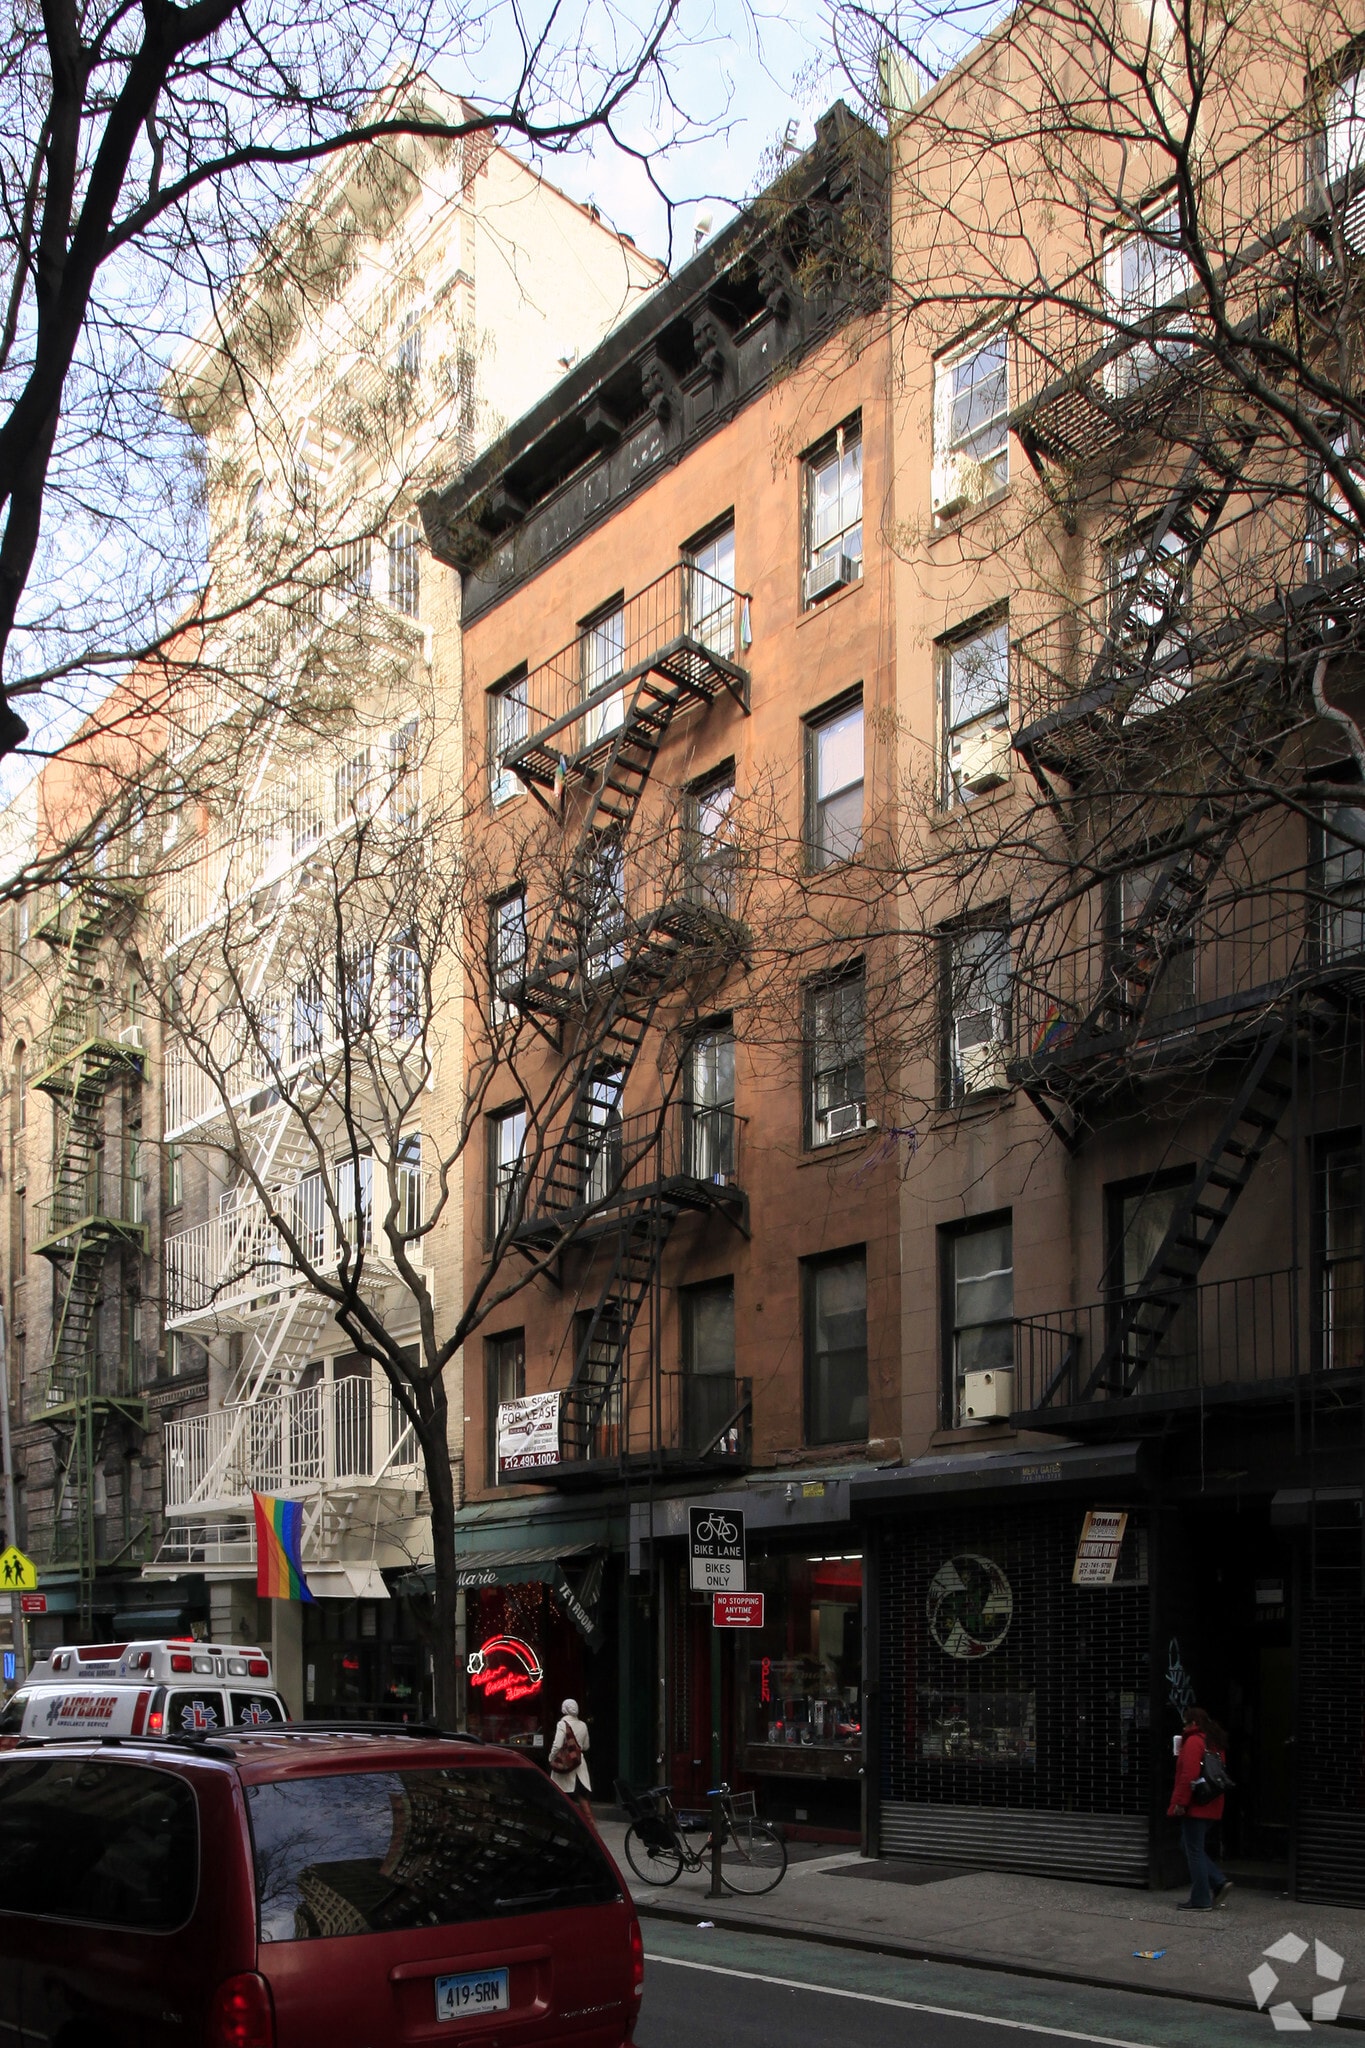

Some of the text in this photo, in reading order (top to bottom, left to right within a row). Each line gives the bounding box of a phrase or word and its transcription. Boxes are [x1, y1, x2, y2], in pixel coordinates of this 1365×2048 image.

[501, 1393, 559, 1412] RETAIL SPACE
[502, 1405, 557, 1425] FOR LEASE
[504, 1452, 557, 1470] 212.490.1002
[1089, 1517, 1121, 1527] DOMAIN
[694, 1544, 742, 1557] BIKE LANE
[456, 1568, 499, 1586] Marie
[705, 1563, 731, 1574] BIKES
[706, 1576, 730, 1587] ONLY
[717, 1597, 760, 1605] NO STOPPING
[724, 1606, 752, 1614] ANYTIME
[572, 1601, 596, 1634] ROOM
[761, 1655, 771, 1703] OPEN
[60, 1697, 118, 1718] LIFELINE
